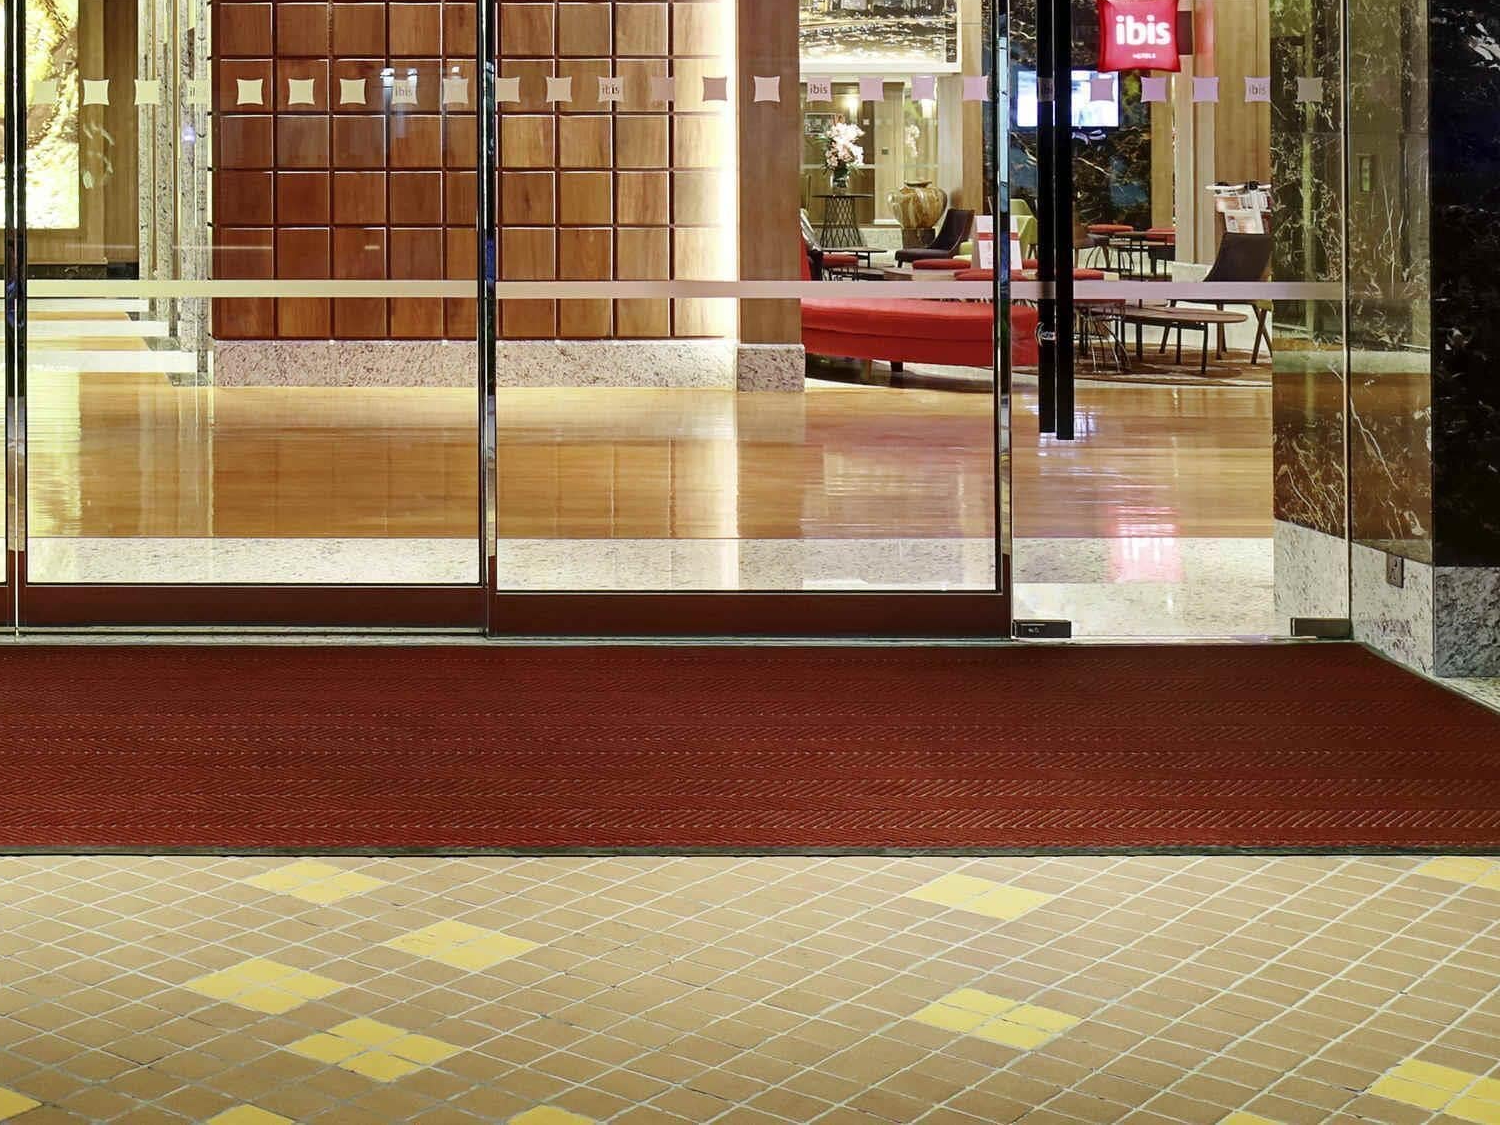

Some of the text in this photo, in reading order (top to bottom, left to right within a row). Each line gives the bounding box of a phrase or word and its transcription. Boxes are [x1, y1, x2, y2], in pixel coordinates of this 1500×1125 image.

[1116, 15, 1171, 45] ibis
[809, 83, 828, 94] ibis
[1248, 84, 1267, 95] ibis
